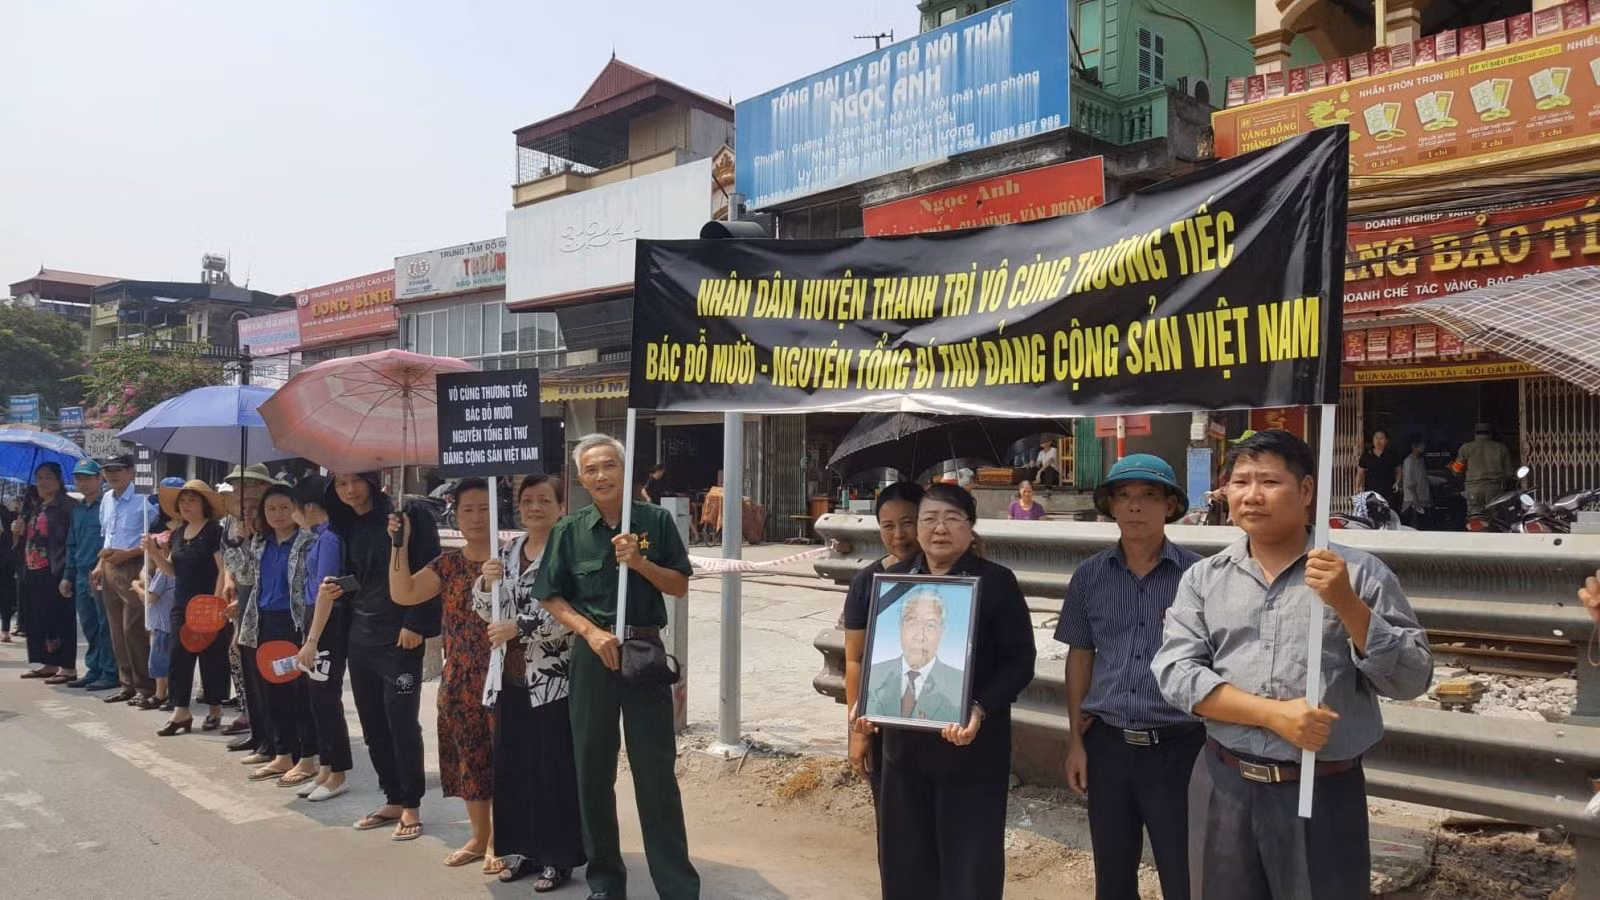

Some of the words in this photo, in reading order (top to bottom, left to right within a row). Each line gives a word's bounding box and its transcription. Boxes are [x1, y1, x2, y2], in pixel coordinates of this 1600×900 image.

[1481, 140, 1488, 149] 2
[919, 194, 969, 216] Ngọc
[977, 179, 1020, 203] Anh
[1365, 216, 1400, 230] DOANH
[440, 247, 465, 259] TRUNG
[696, 270, 753, 318] NHÂN
[752, 270, 797, 319] DÂN
[799, 269, 868, 330] HUYỆN
[871, 275, 940, 321] THANH
[942, 262, 979, 318] TRÌ
[978, 257, 1009, 314] VÔ
[1007, 253, 1072, 311] CÙNG
[1072, 227, 1168, 293] THƯƠNG
[1168, 195, 1236, 276] TIẾC
[1383, 282, 1409, 299] CHẾ
[1416, 280, 1438, 296] TÁC
[645, 334, 681, 383] BÁC
[684, 328, 707, 384] ĐỖ
[709, 333, 757, 385] MƯỜI
[771, 340, 853, 390] NGUYÊN
[856, 332, 911, 390] TỔNG
[913, 336, 938, 390] BÍ
[939, 337, 980, 388] THƯ
[981, 318, 1046, 387] ĐẢNG
[1053, 317, 1119, 391] CỘNG
[1126, 294, 1183, 375] SẢN
[1186, 295, 1249, 379] VIỆT
[1256, 296, 1320, 363] NAM
[511, 379, 528, 399] TIẾC
[465, 405, 480, 422] BÁC
[493, 402, 513, 421] MƯỜI
[452, 426, 482, 444] NGUYÊN
[483, 423, 503, 442] TỔNG
[504, 424, 512, 441] BÍ
[513, 424, 529, 440] THƯ
[443, 446, 464, 465] ĐẢNG
[465, 447, 486, 467] CỘNG
[487, 443, 503, 463] SẢN
[503, 445, 521, 464] VIỆT
[520, 446, 539, 461] NAM
